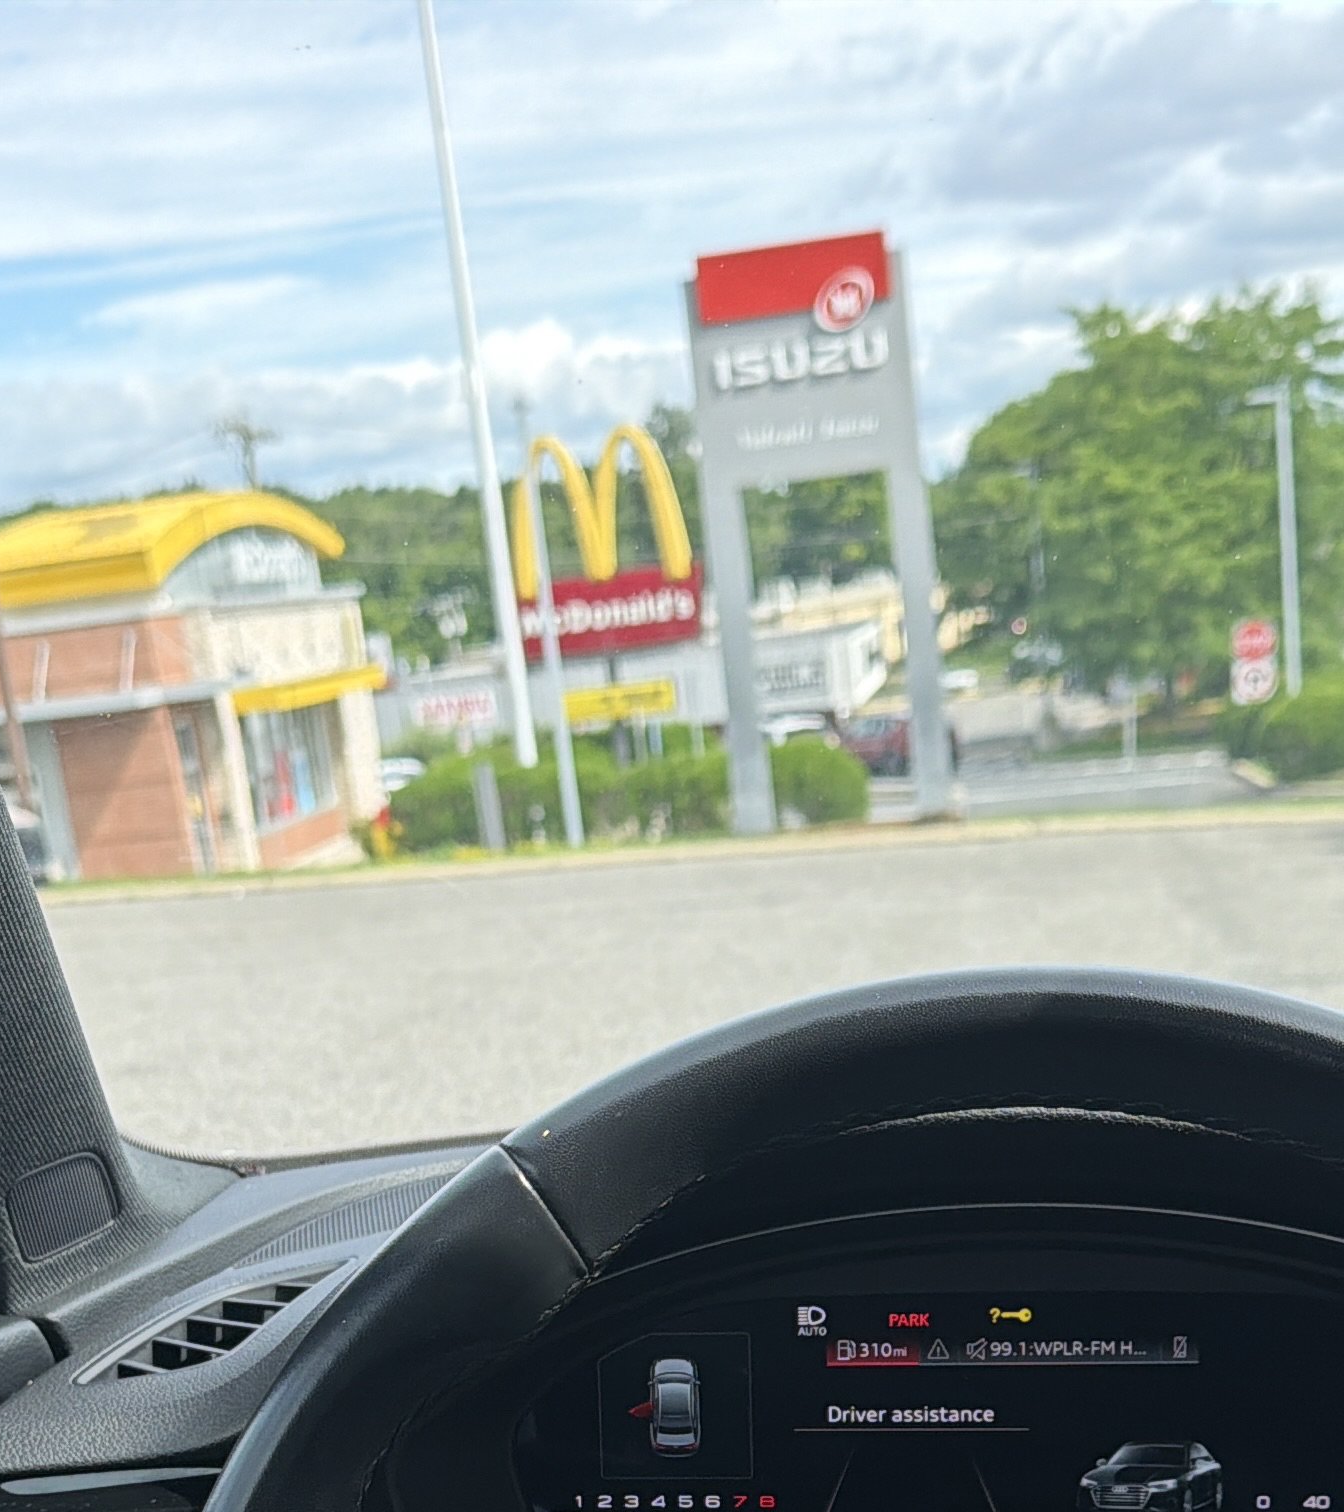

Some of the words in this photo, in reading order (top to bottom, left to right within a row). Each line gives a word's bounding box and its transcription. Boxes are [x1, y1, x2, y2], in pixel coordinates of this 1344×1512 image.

[712, 326, 890, 391] ISUZU
[888, 1312, 930, 1327] PARK
[797, 1327, 827, 1336] AUTO
[828, 1406, 887, 1423] Driver
[891, 1406, 995, 1423] assistance
[575, 1495, 583, 1508] 1
[598, 1495, 612, 1508] 2
[625, 1495, 639, 1508] 3
[651, 1495, 666, 1508] 4
[678, 1495, 693, 1508] 5
[705, 1495, 720, 1508] 6
[734, 1495, 747, 1508] 7
[760, 1495, 775, 1508] 8
[1257, 1495, 1270, 1510] 0
[1302, 1495, 1330, 1510] 40
